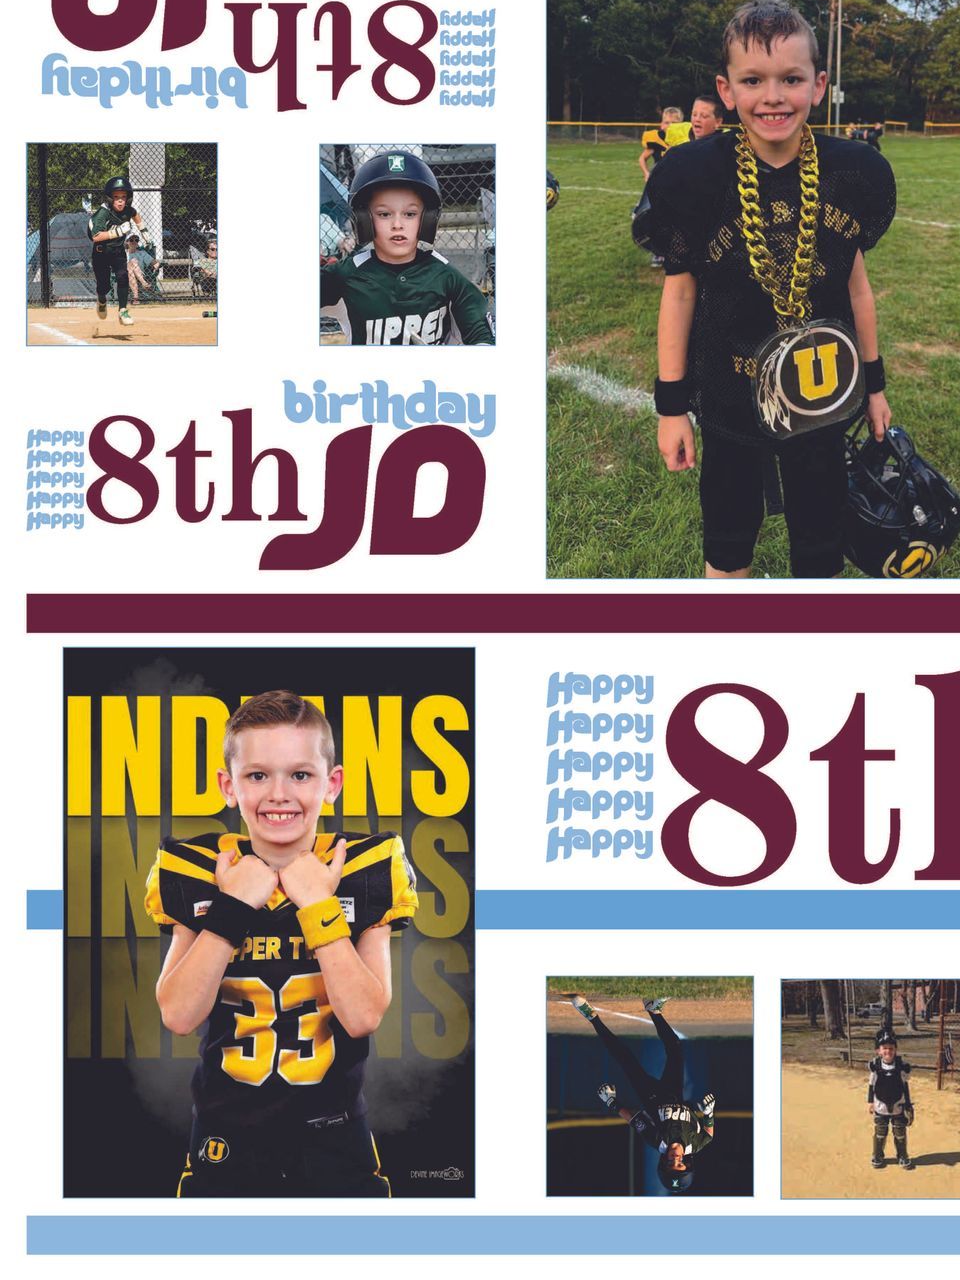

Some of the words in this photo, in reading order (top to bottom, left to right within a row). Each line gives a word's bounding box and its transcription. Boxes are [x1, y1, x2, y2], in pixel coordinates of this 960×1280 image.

[440, 9, 495, 27] Happy
[440, 29, 495, 47] Happy
[225, 0, 437, 111] 8th
[440, 49, 495, 67] Happy
[42, 53, 247, 108] birthday
[440, 69, 495, 87] Happy
[440, 89, 495, 107] Happy
[793, 341, 840, 402] U
[282, 380, 496, 437] birthday
[27, 429, 84, 449] Happy
[27, 451, 84, 469] Happy
[87, 409, 307, 524] 8th
[27, 471, 84, 489] Happy
[27, 491, 84, 510] Happy
[27, 511, 84, 530] Happy
[547, 672, 653, 707] Happy
[547, 711, 653, 746] Happy
[67, 694, 471, 817] INDNS
[547, 750, 653, 784] Happy
[547, 788, 653, 823] Happy
[547, 827, 653, 862] Happy
[220, 973, 336, 1086] 33
[658, 1107, 691, 1122] UPPER
